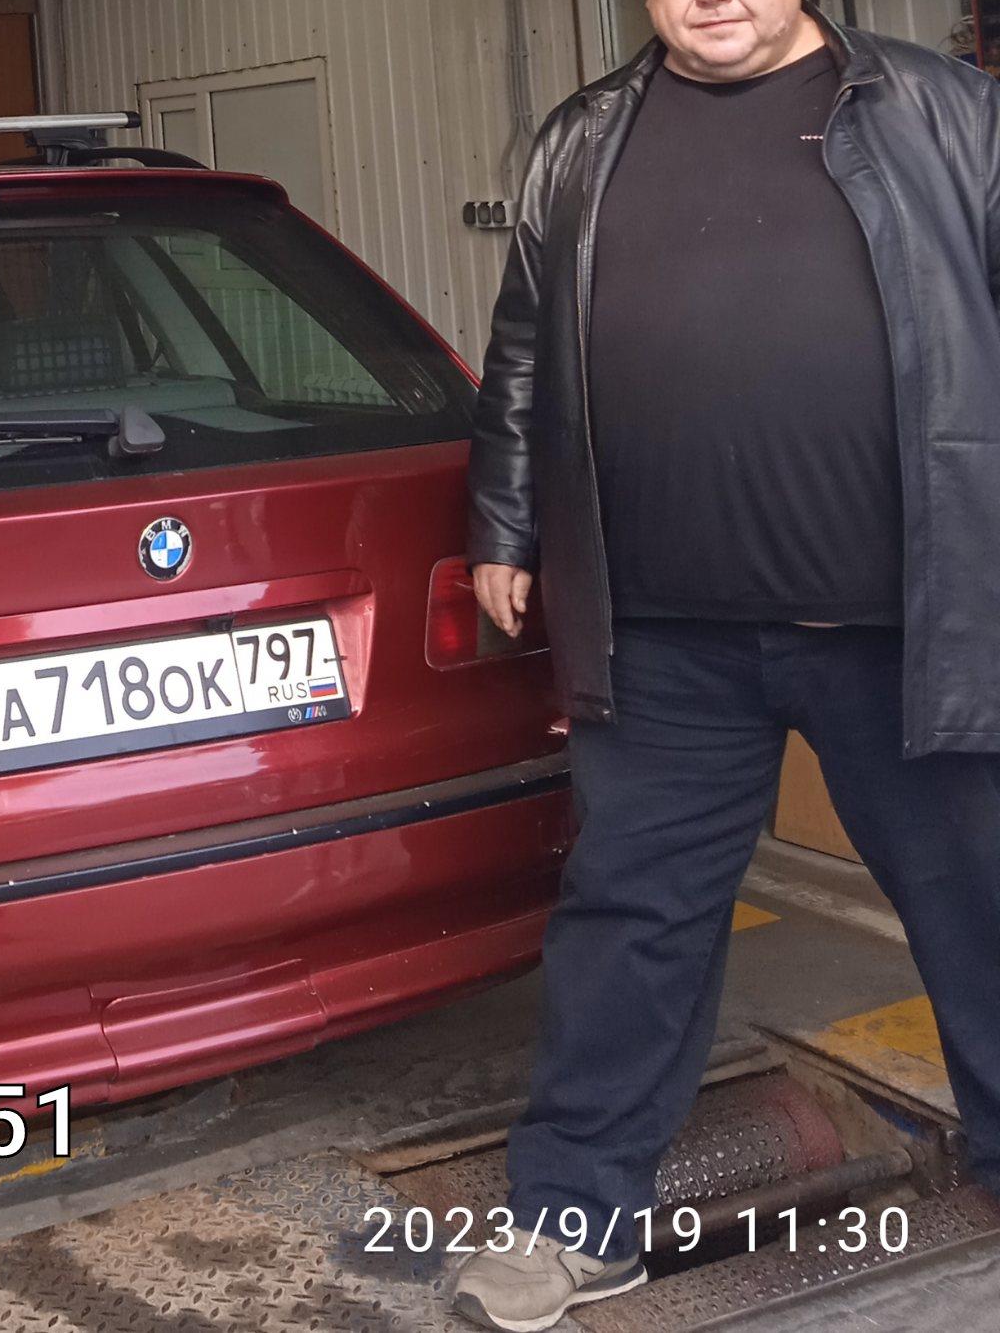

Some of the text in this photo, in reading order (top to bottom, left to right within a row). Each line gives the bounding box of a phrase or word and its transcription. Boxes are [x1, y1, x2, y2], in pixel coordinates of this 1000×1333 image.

[146, 519, 188, 541] BMW
[236, 628, 316, 685] 797
[268, 682, 308, 703] RUS
